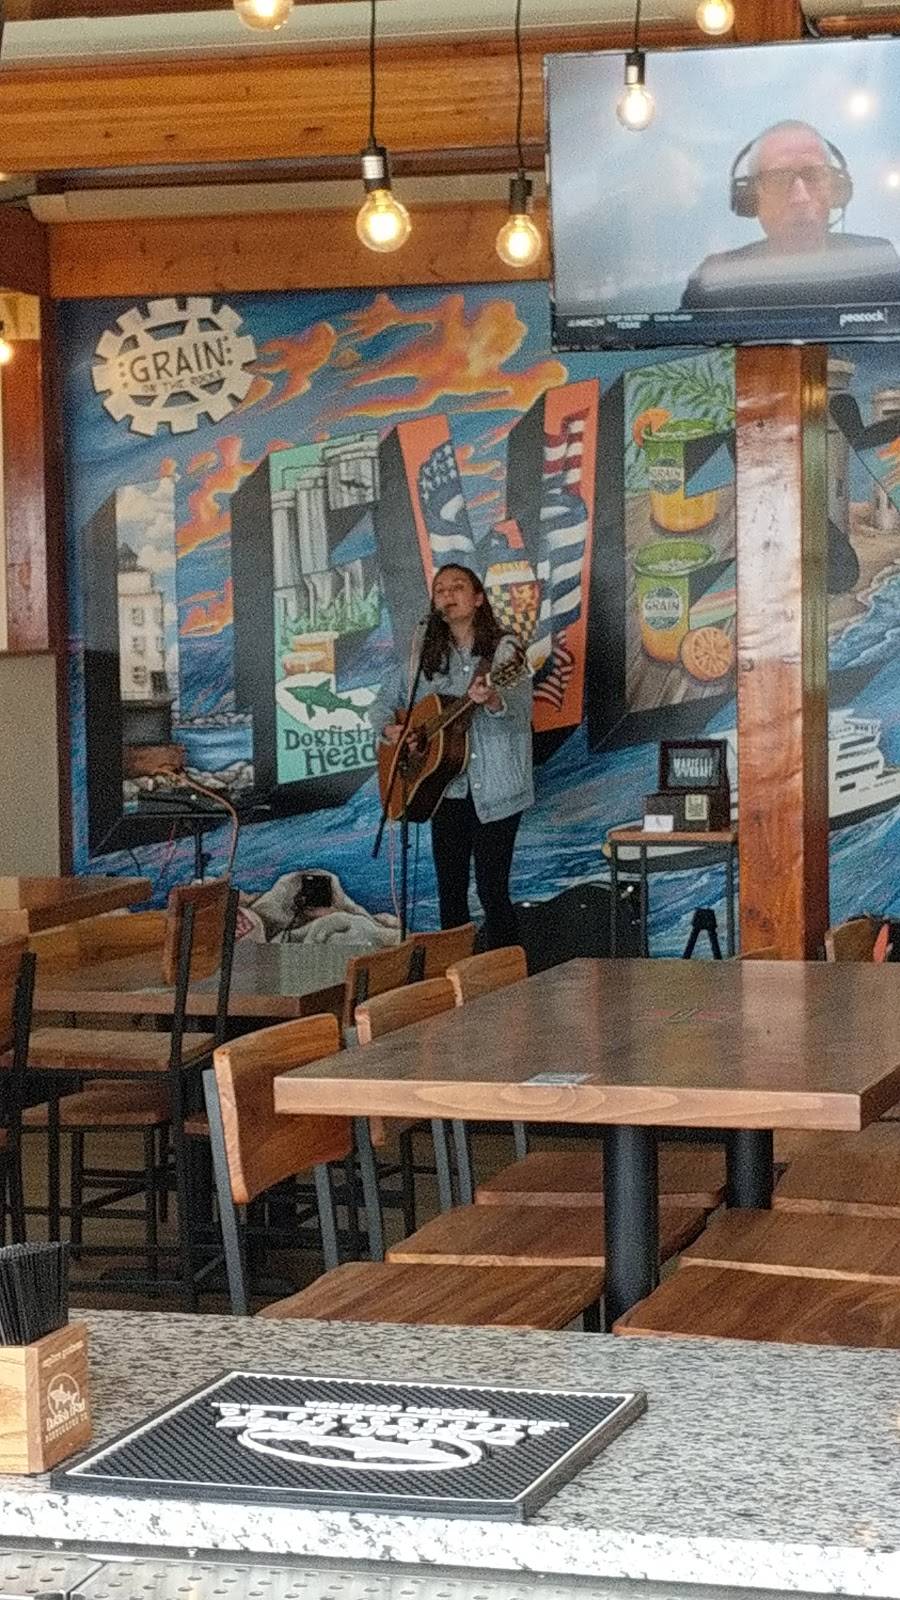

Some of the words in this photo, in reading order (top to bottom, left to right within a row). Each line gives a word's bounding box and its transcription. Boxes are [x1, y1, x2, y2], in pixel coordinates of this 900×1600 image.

[130, 338, 225, 382] GRAIN
[644, 599, 680, 611] GRAIN
[284, 723, 374, 751] Dogfish
